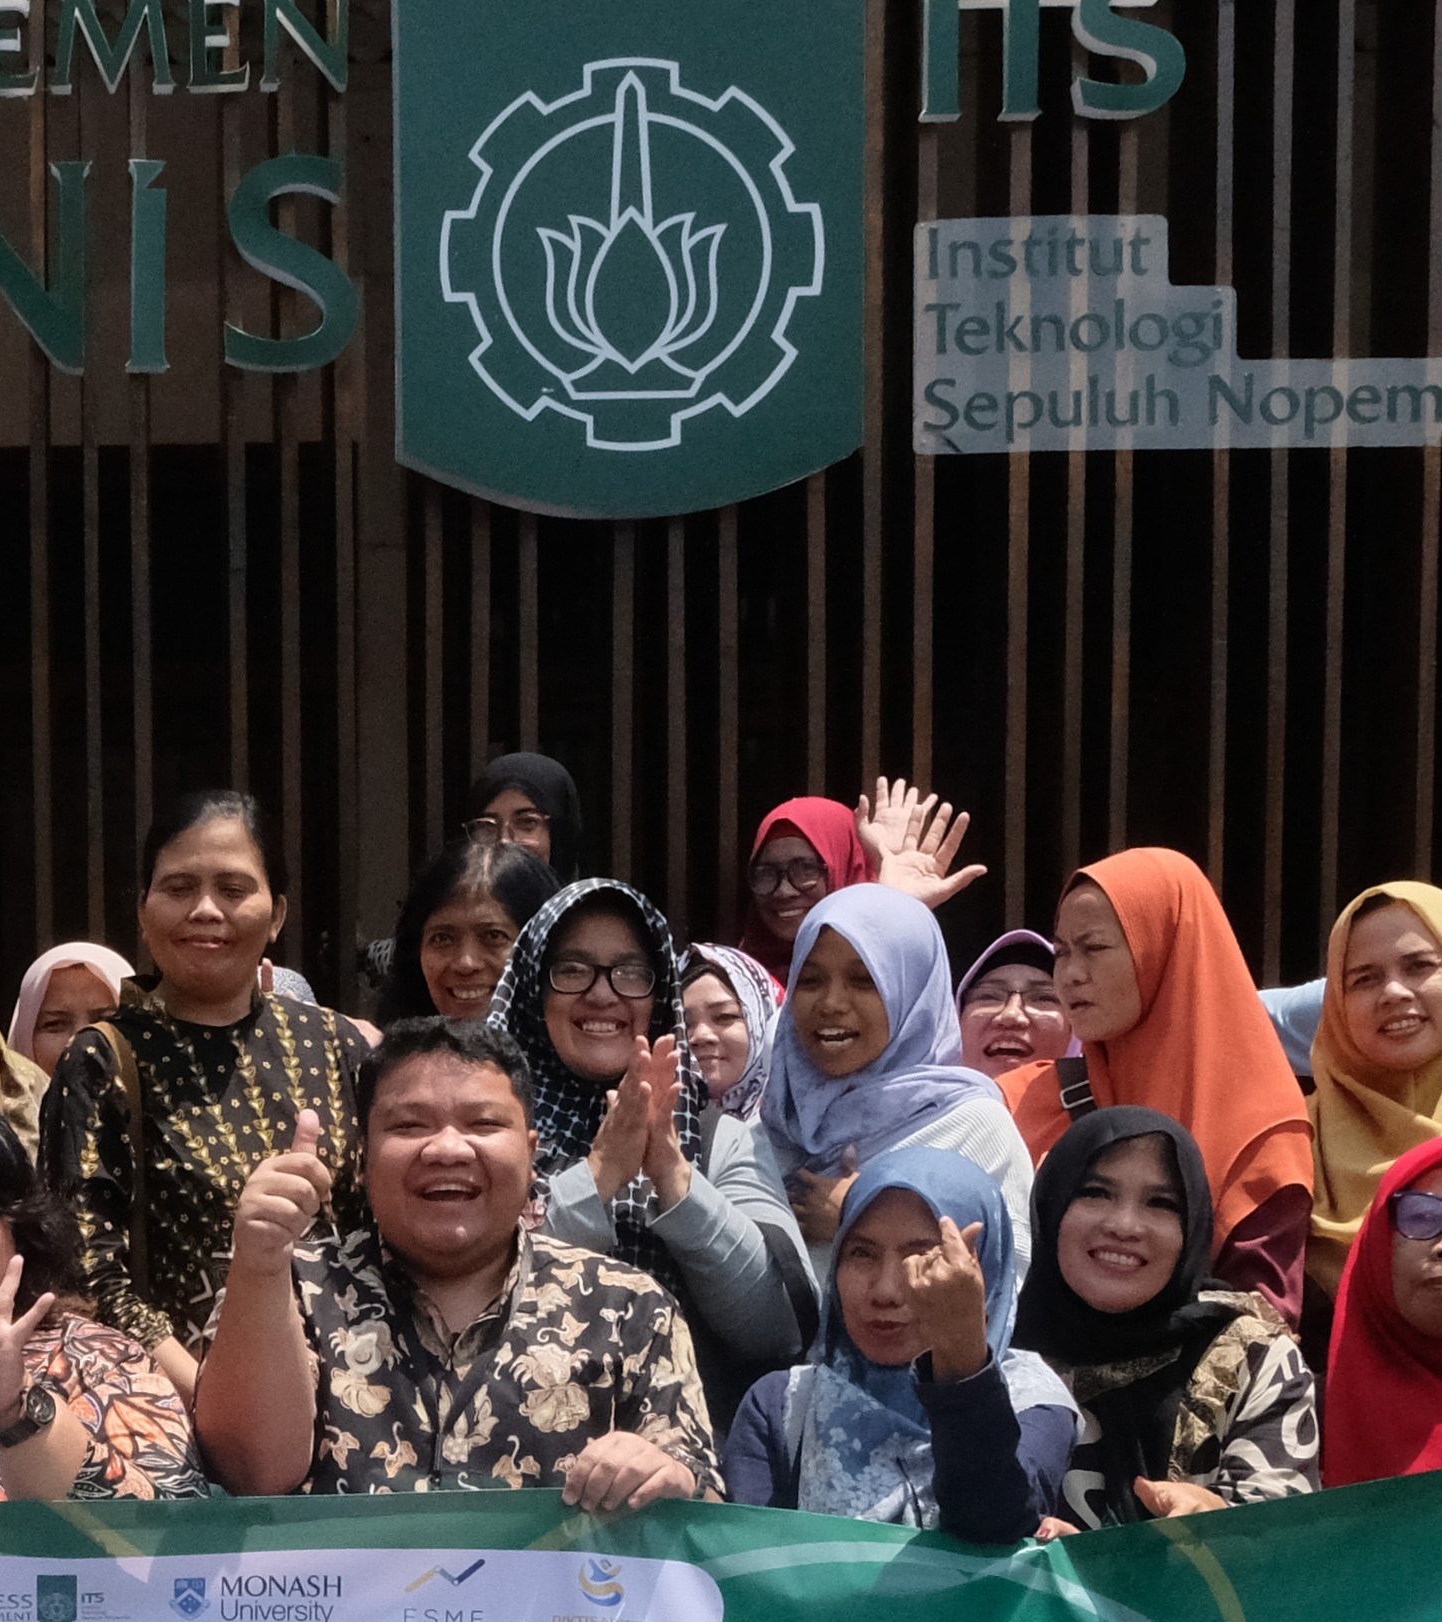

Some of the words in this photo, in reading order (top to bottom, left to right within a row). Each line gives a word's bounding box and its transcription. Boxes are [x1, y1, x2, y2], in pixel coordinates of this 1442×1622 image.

[926, 226, 1151, 279] Institut
[923, 296, 1226, 368] Teknologi
[922, 374, 1180, 442] Sepuluh
[80, 1591, 105, 1604] ITS
[221, 1574, 342, 1597] MONASH
